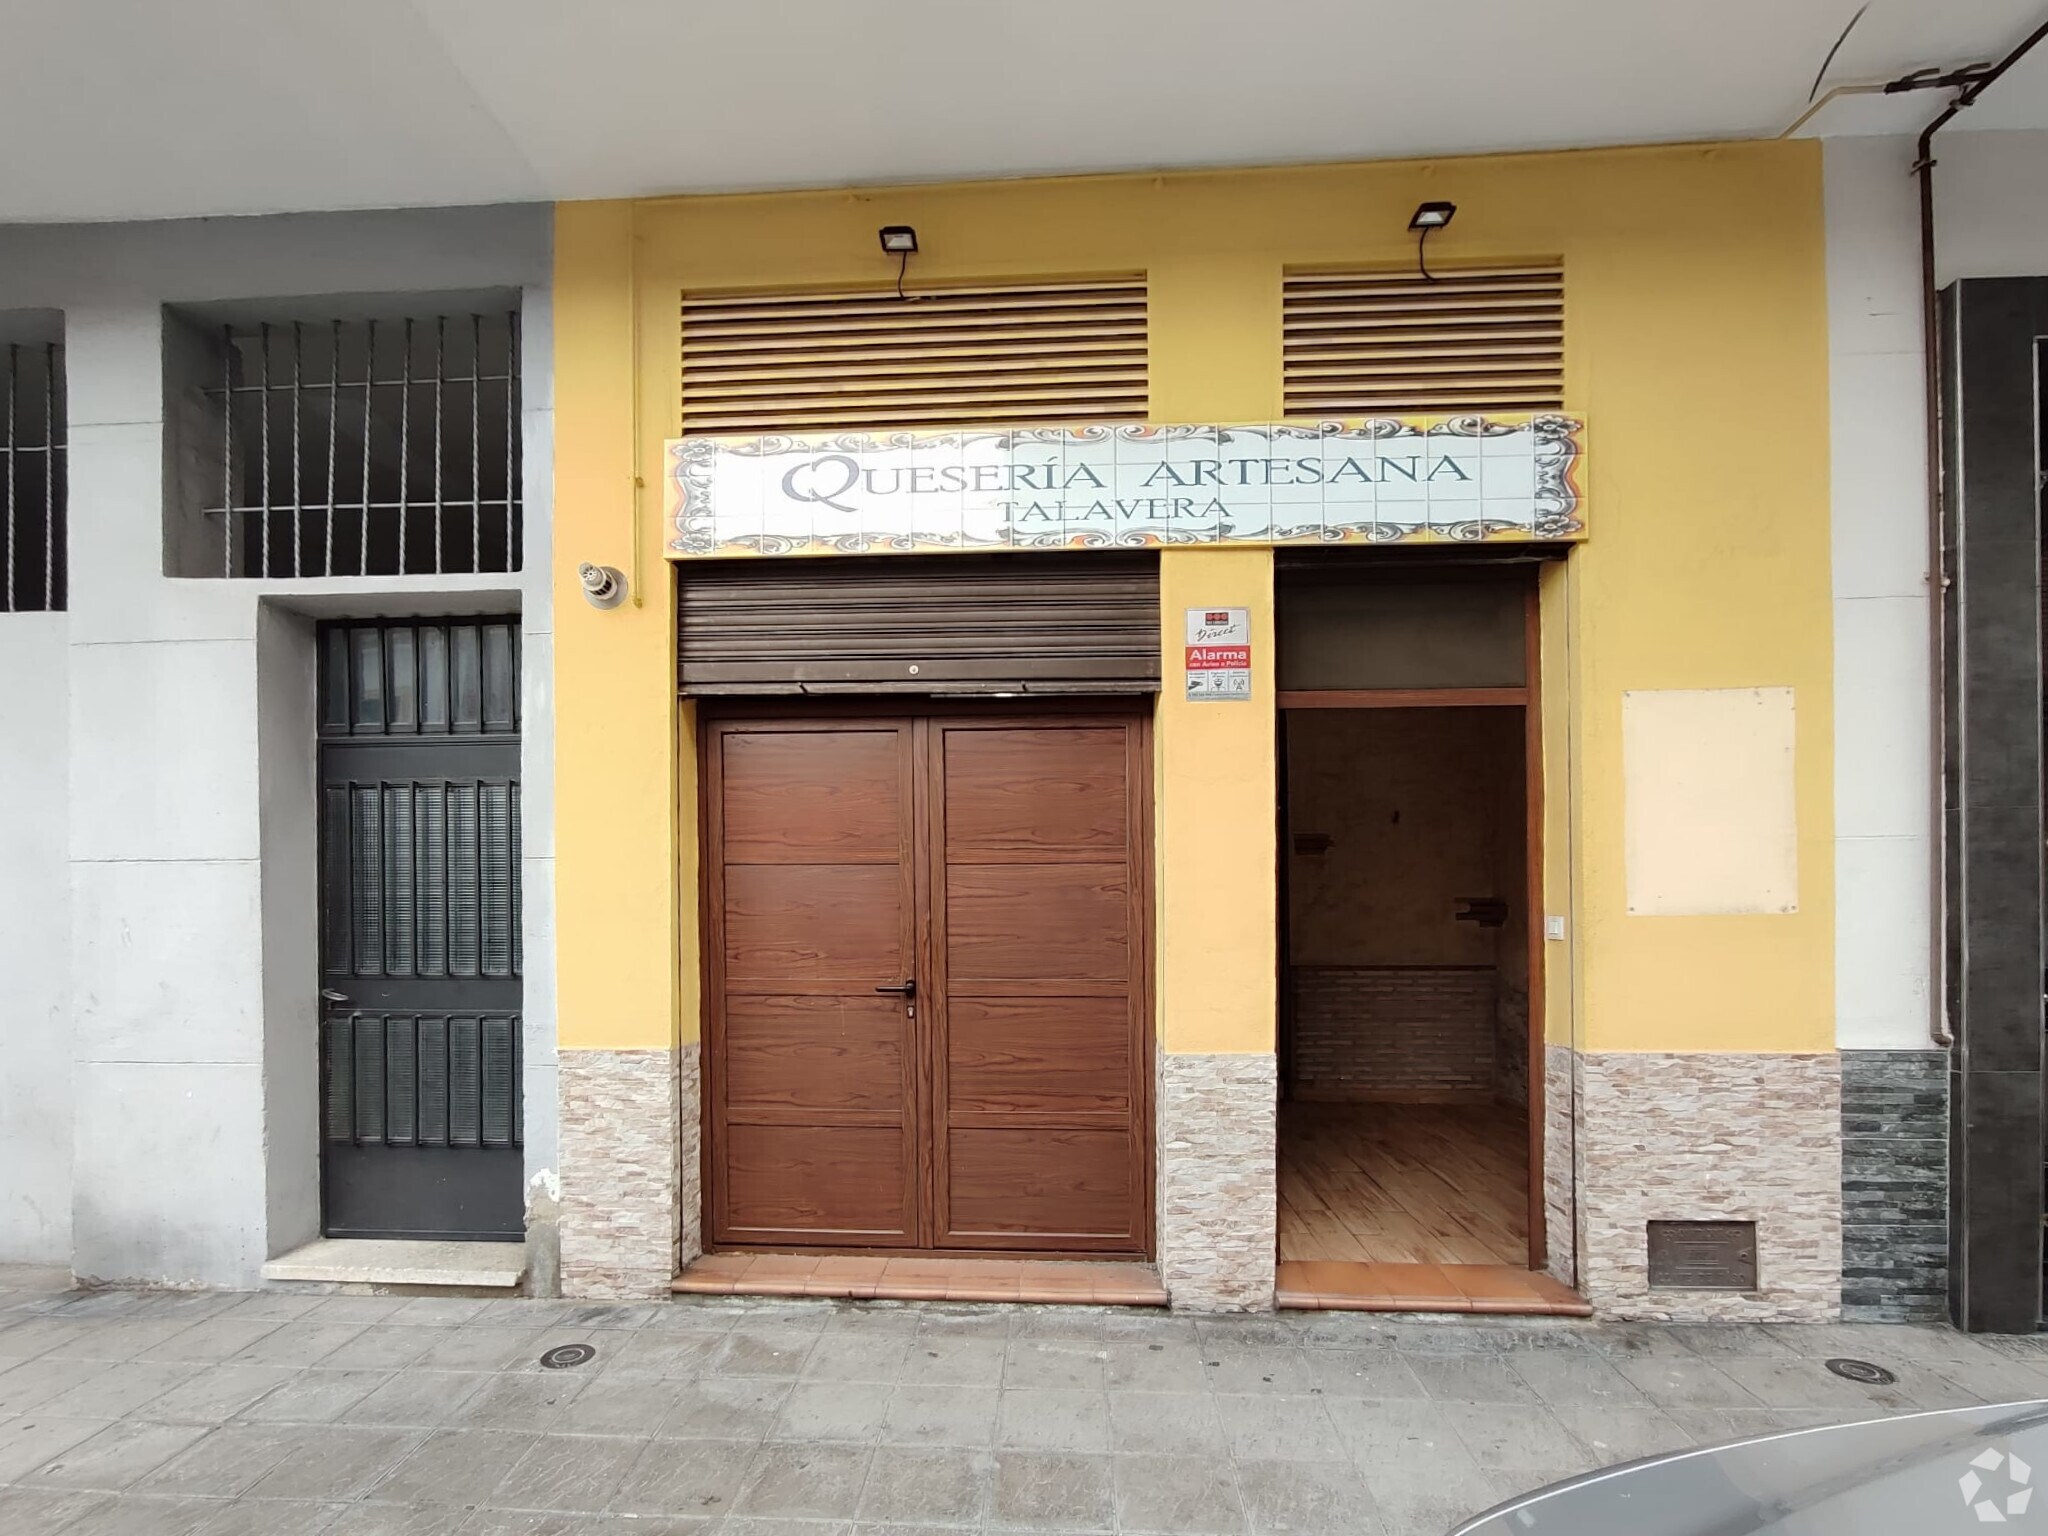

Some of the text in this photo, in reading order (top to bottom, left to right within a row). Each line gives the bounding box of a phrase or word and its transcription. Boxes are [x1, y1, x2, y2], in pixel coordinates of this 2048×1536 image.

[1140, 454, 1472, 487] ARTESANA
[996, 497, 1234, 522] TALAVERA
[1190, 649, 1247, 660] Alarma
